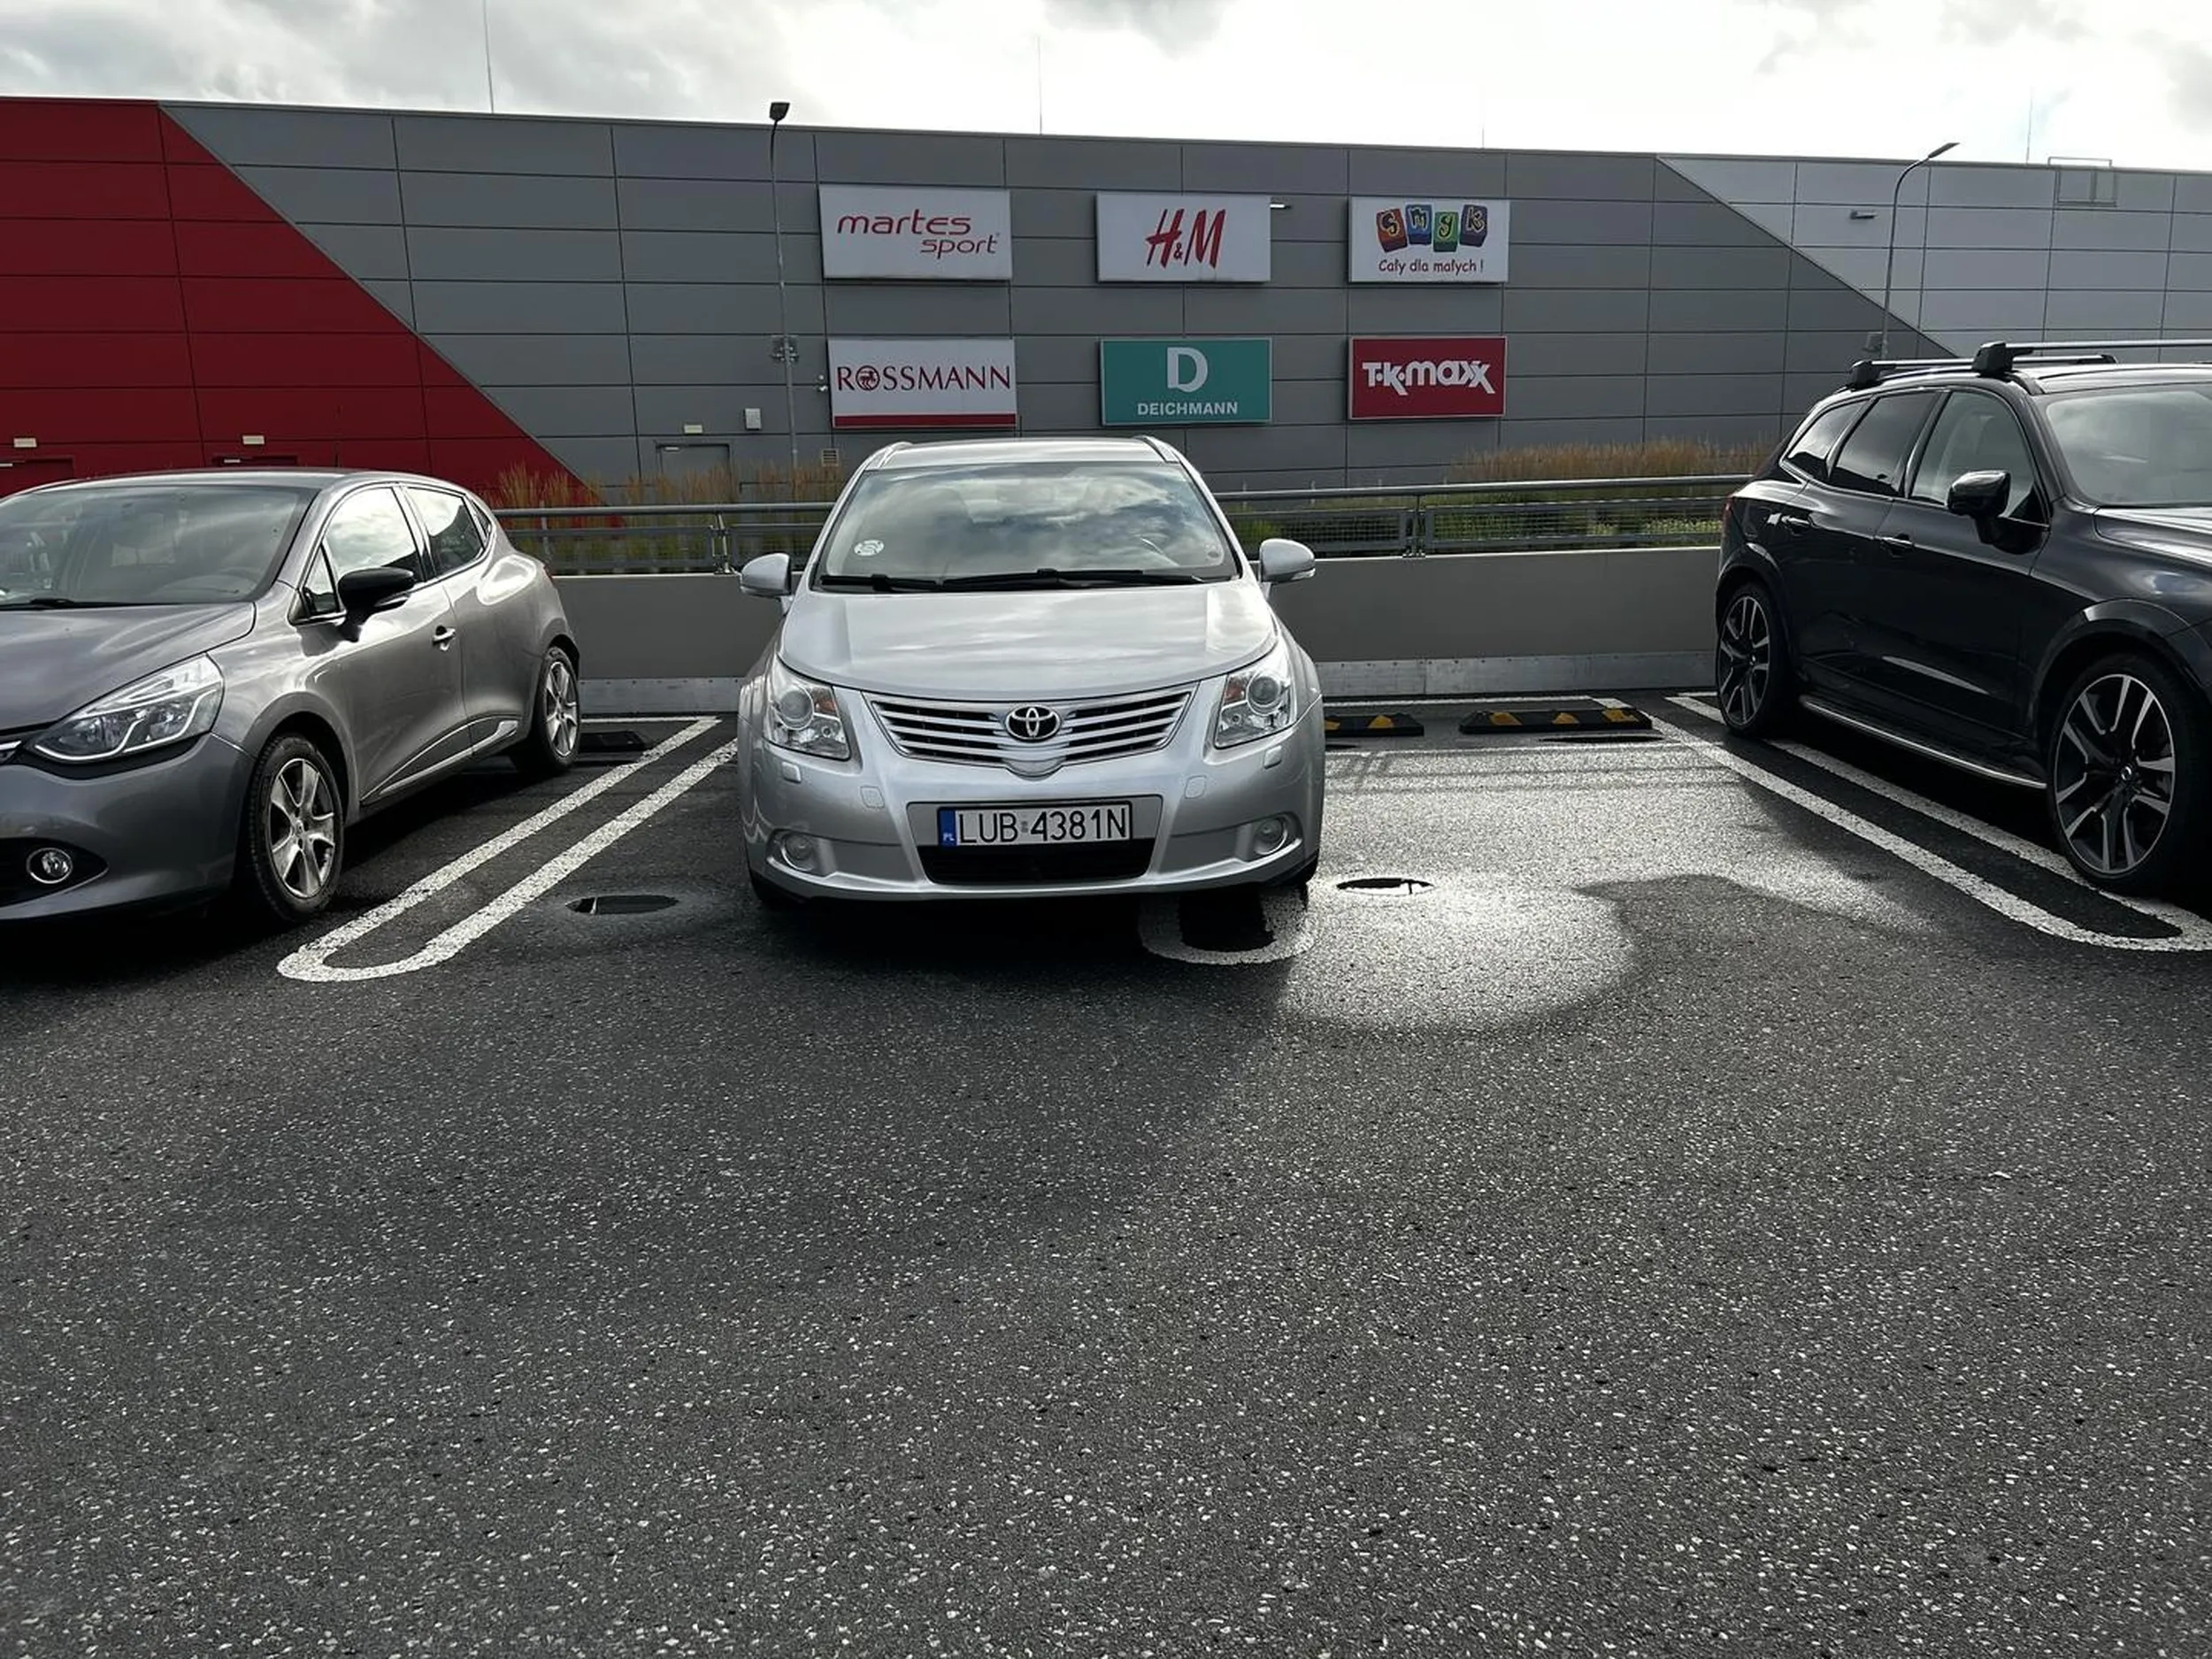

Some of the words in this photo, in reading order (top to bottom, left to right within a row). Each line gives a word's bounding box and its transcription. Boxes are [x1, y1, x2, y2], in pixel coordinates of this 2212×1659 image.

[837, 209, 972, 235] martes
[920, 234, 997, 258] sport
[1146, 209, 1226, 268] H&M
[1379, 259, 1405, 275] Cały
[1410, 259, 1429, 272] dla
[1433, 259, 1477, 276] małych
[837, 365, 1010, 391] ROSSMANN
[1167, 347, 1208, 393] D
[1137, 403, 1238, 416] DEICHMANN
[959, 812, 1018, 843] LUB
[1031, 808, 1126, 841] 4381N
